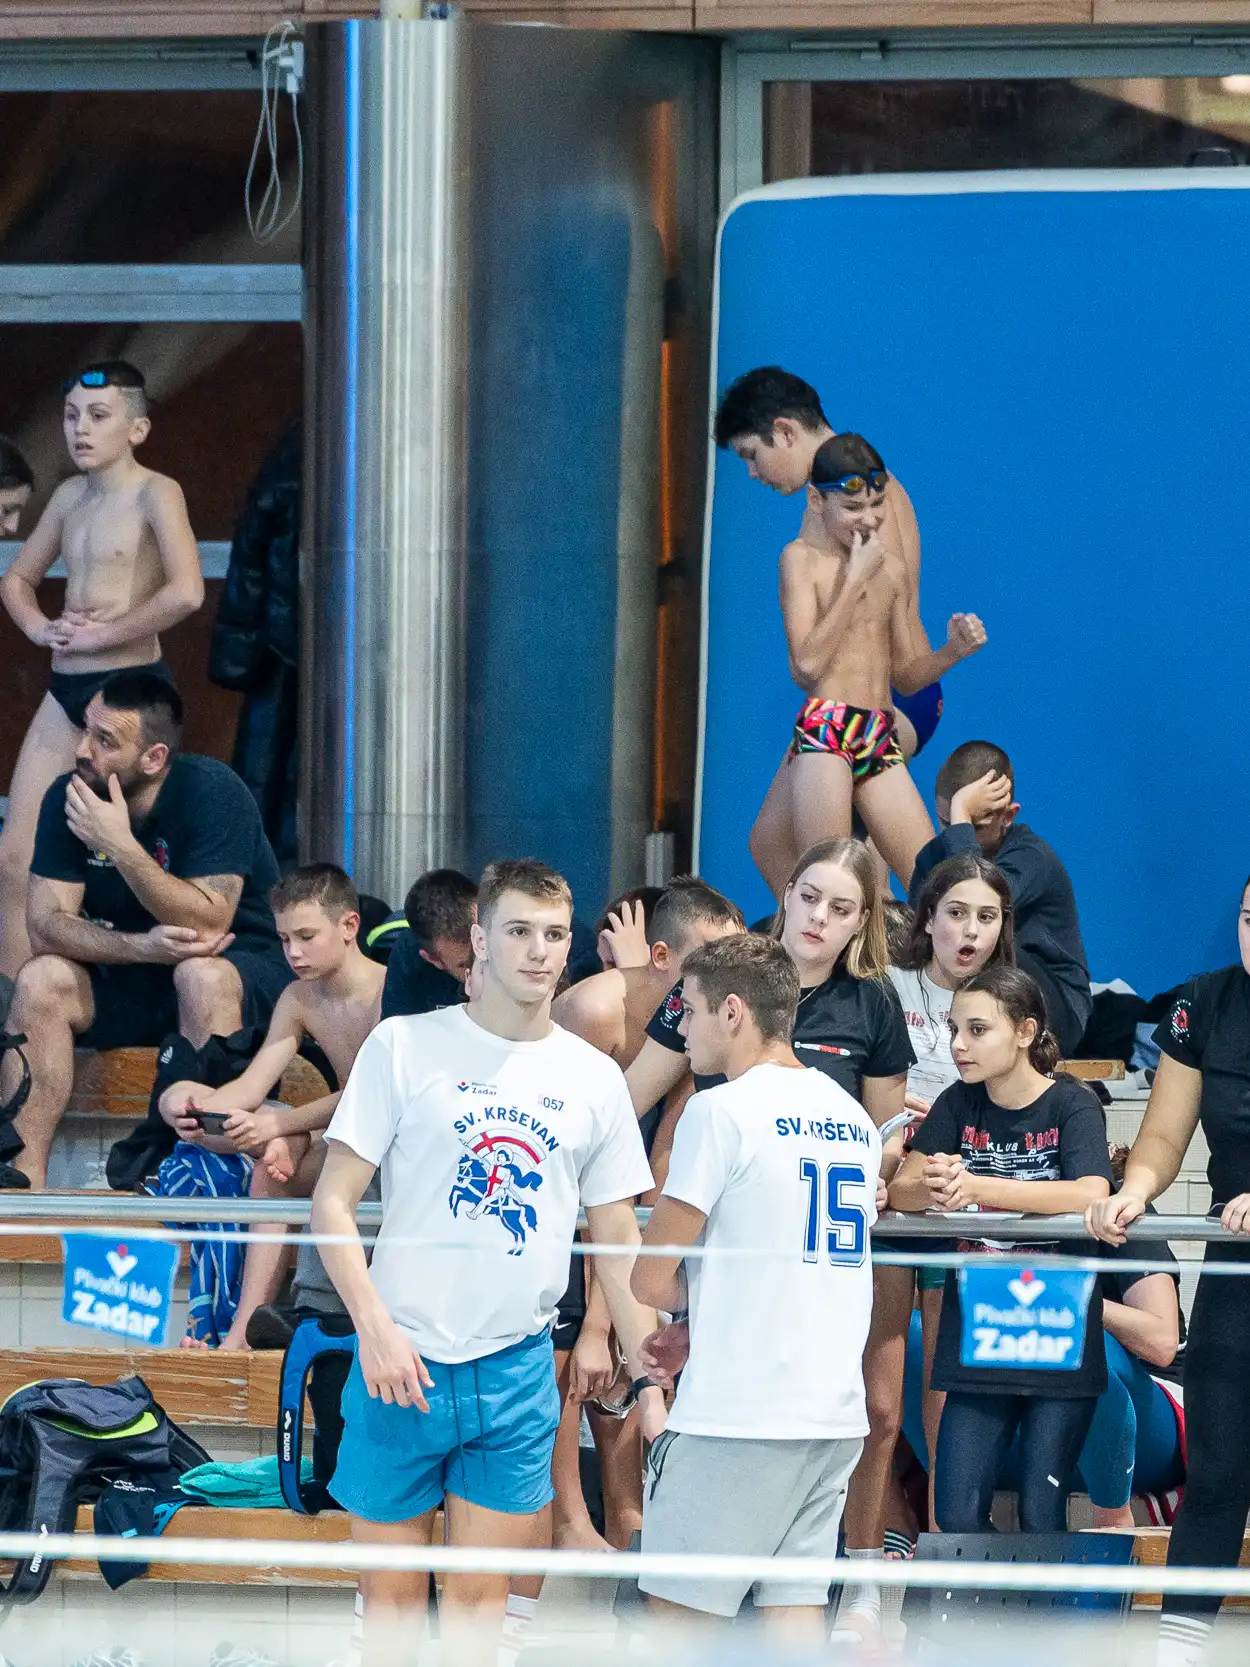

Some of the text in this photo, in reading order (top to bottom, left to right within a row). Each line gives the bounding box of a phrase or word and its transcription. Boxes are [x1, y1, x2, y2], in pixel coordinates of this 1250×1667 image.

[453, 1106, 560, 1153] SV. KRŠEVAN
[808, 1118, 870, 1148] KRŠEVAN
[799, 1157, 868, 1268] 15
[71, 1290, 160, 1340] Zadar
[972, 1327, 1074, 1363] Zadar
[283, 1432, 291, 1462] arena
